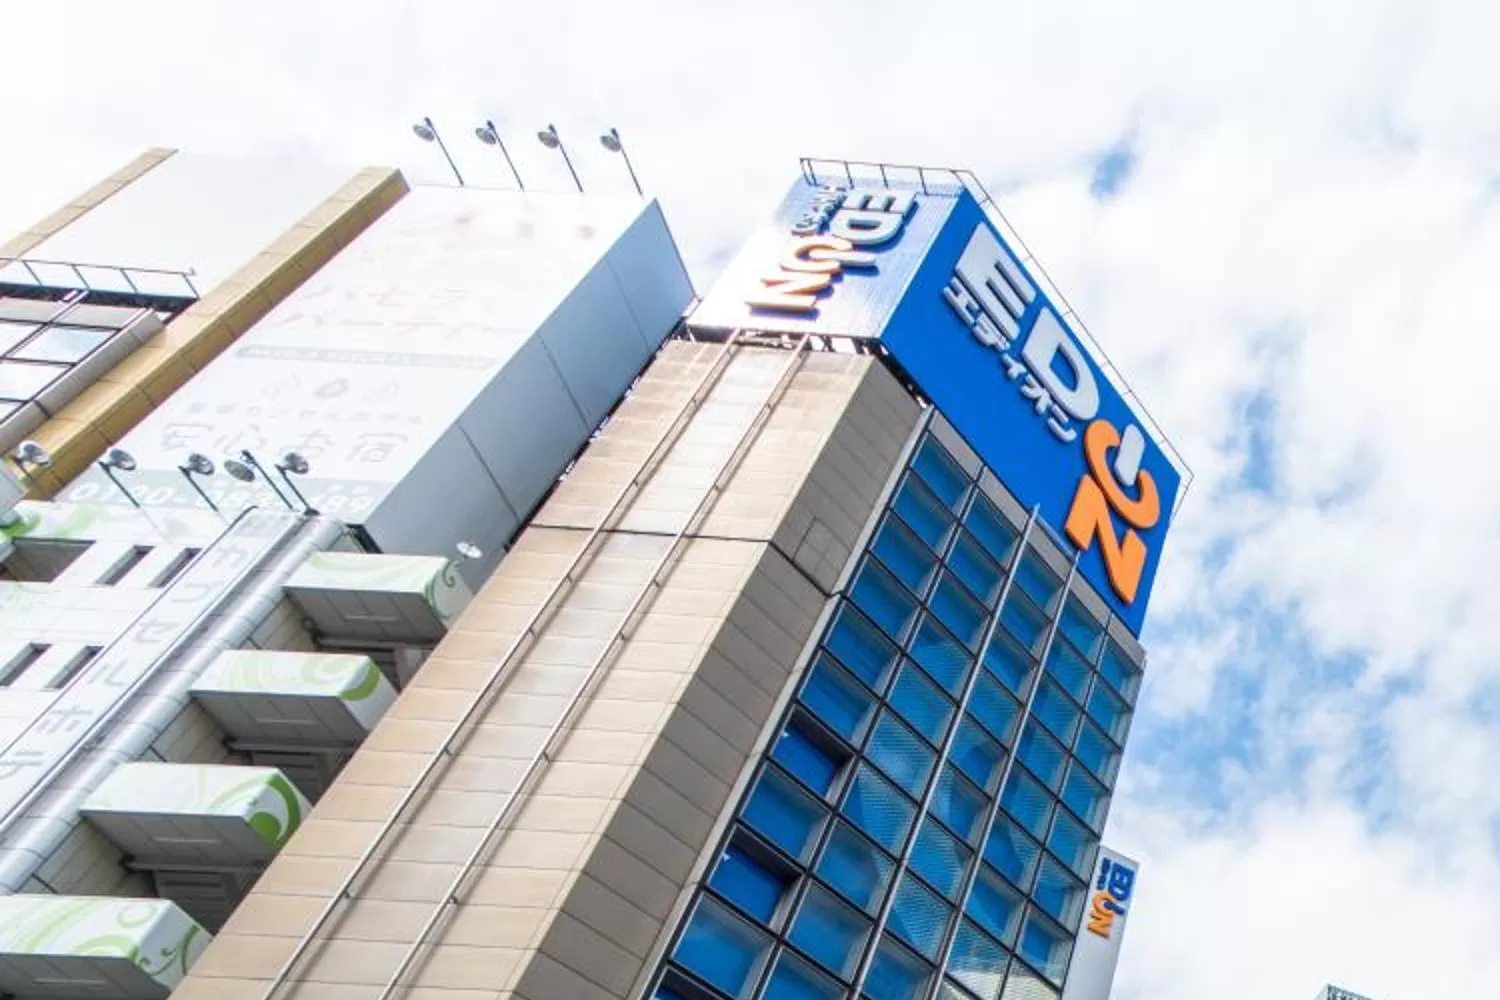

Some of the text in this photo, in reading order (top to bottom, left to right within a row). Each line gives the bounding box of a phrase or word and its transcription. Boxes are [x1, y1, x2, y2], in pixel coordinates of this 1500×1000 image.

[943, 273, 1077, 443] エディオン
[955, 222, 1160, 606] EDION
